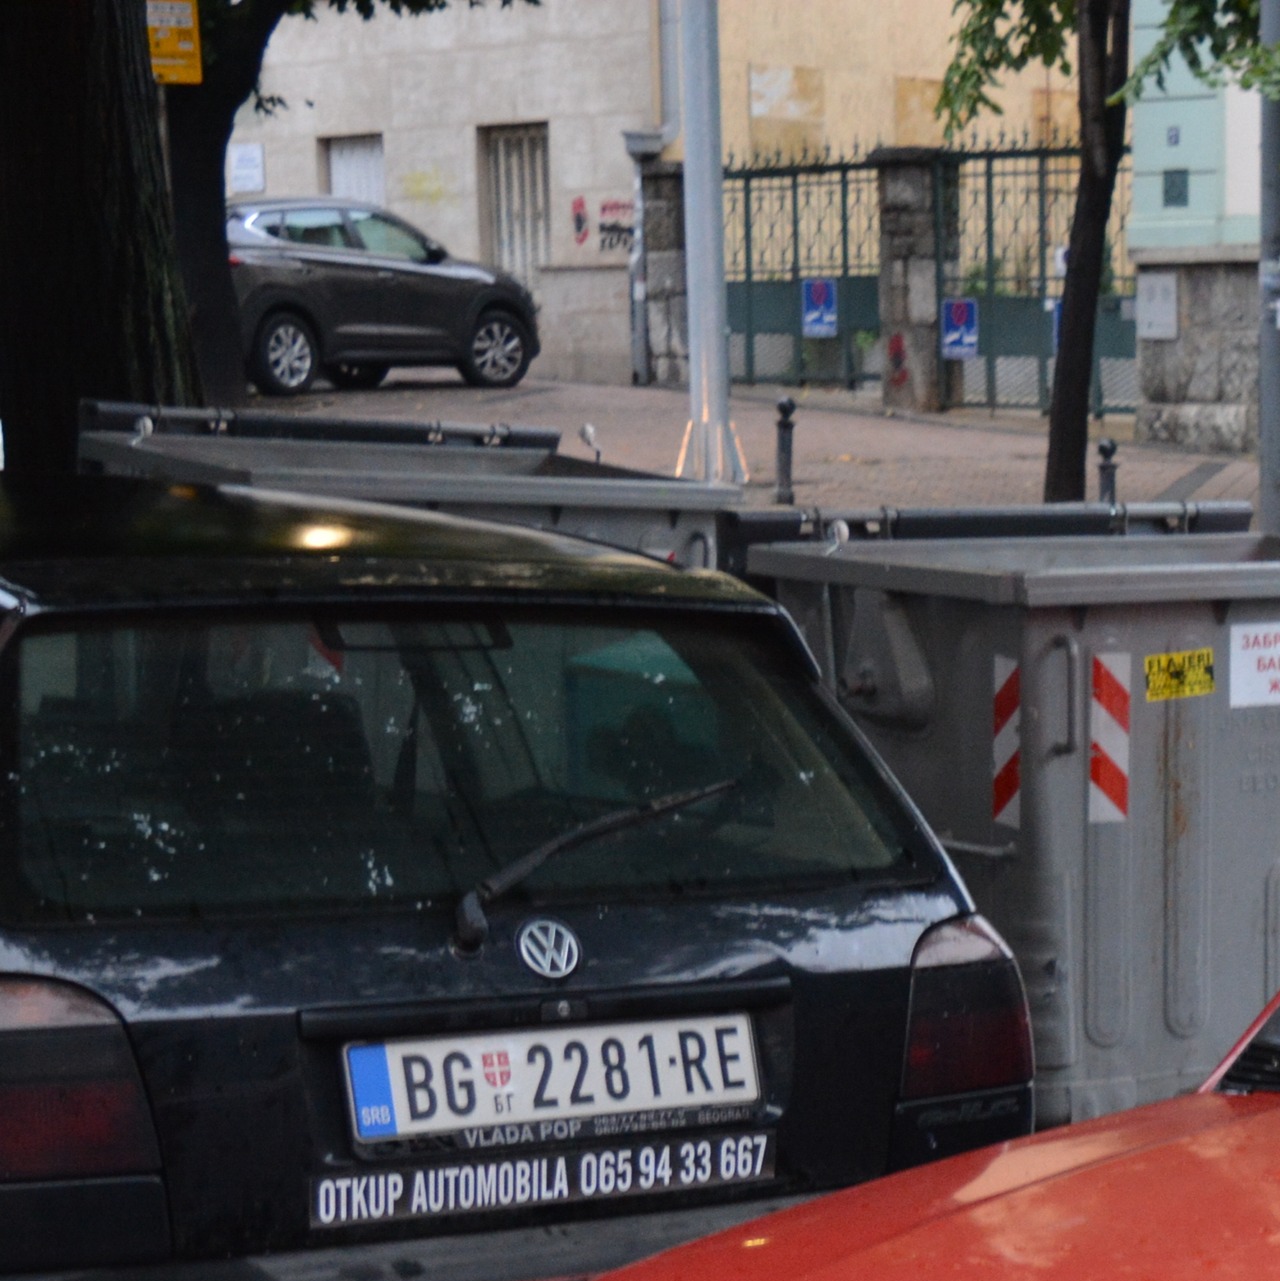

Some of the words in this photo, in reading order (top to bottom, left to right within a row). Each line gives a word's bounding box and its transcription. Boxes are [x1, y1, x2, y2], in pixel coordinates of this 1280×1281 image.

[402, 1051, 477, 1122] BG
[361, 1104, 391, 1126] SRB
[463, 1123, 535, 1148] VLADA
[540, 1118, 582, 1140] POP
[318, 1173, 404, 1224] OTKUP
[411, 1156, 569, 1214] AUTOMOBILA
[580, 1150, 632, 1197] 065
[639, 1145, 672, 1190] 94
[680, 1140, 711, 1184] 33
[720, 1134, 767, 1180] 667
